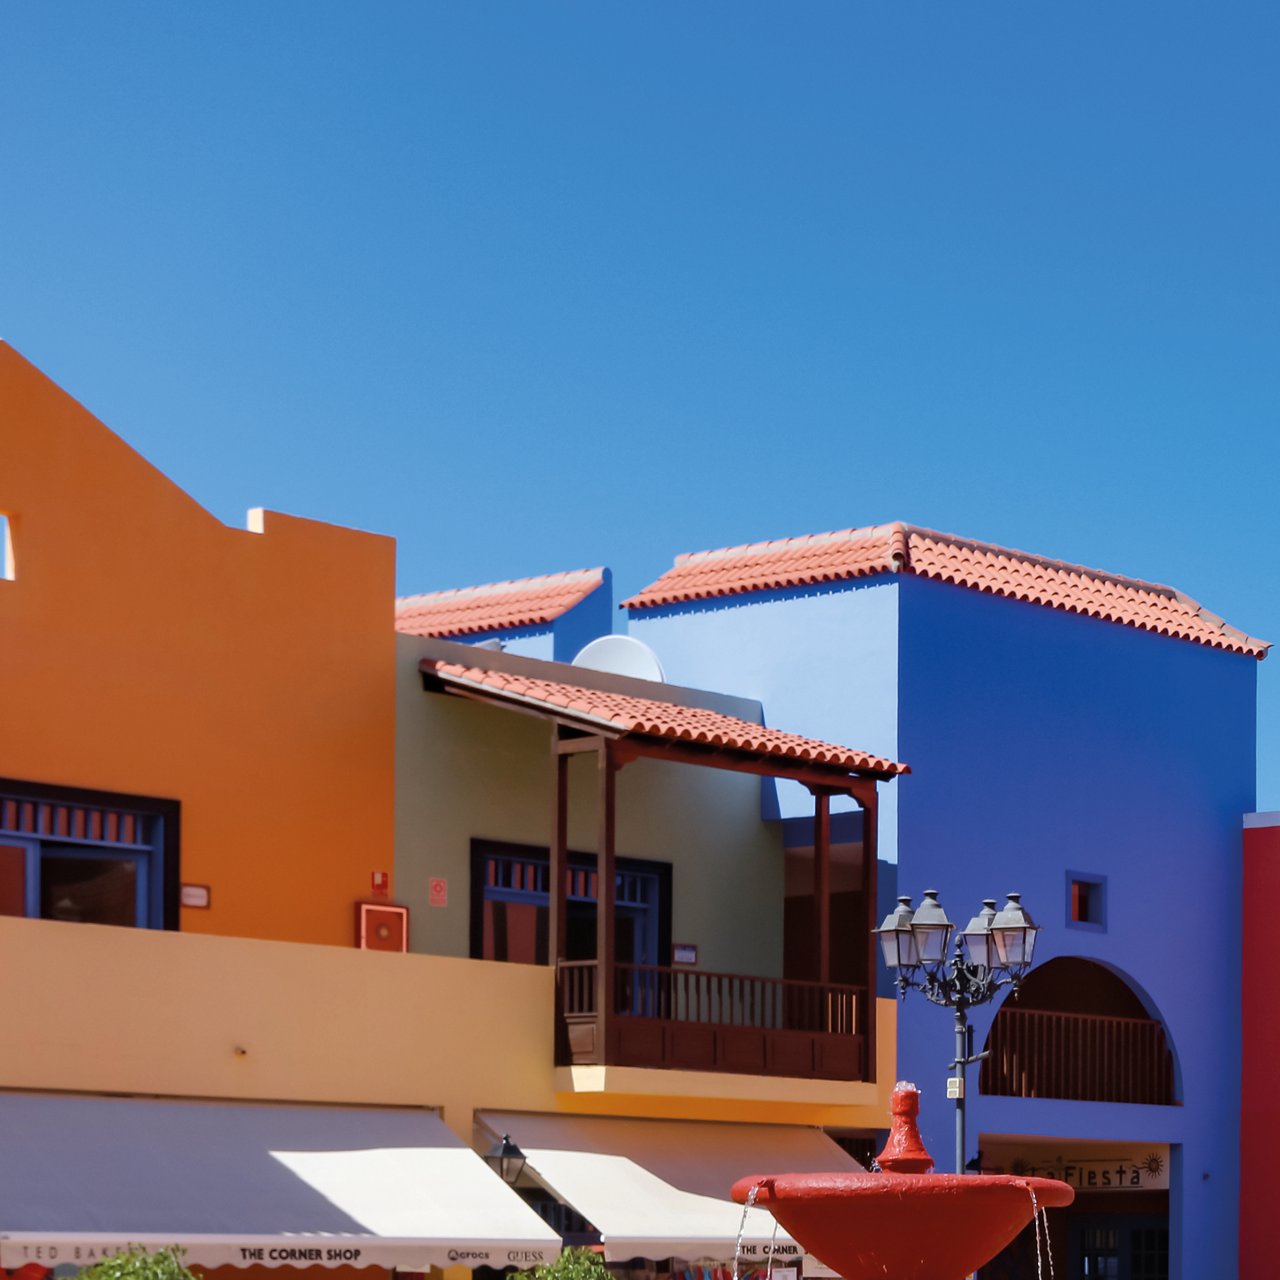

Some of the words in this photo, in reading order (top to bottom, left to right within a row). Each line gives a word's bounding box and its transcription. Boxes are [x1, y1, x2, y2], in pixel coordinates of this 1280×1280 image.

[22, 1246, 58, 1260] TED
[240, 1248, 264, 1260] THE
[269, 1248, 323, 1261] CORNER
[327, 1249, 361, 1261] SHOP
[459, 1251, 490, 1260] crocs
[507, 1250, 544, 1262] GUESS
[742, 1246, 757, 1254] THE
